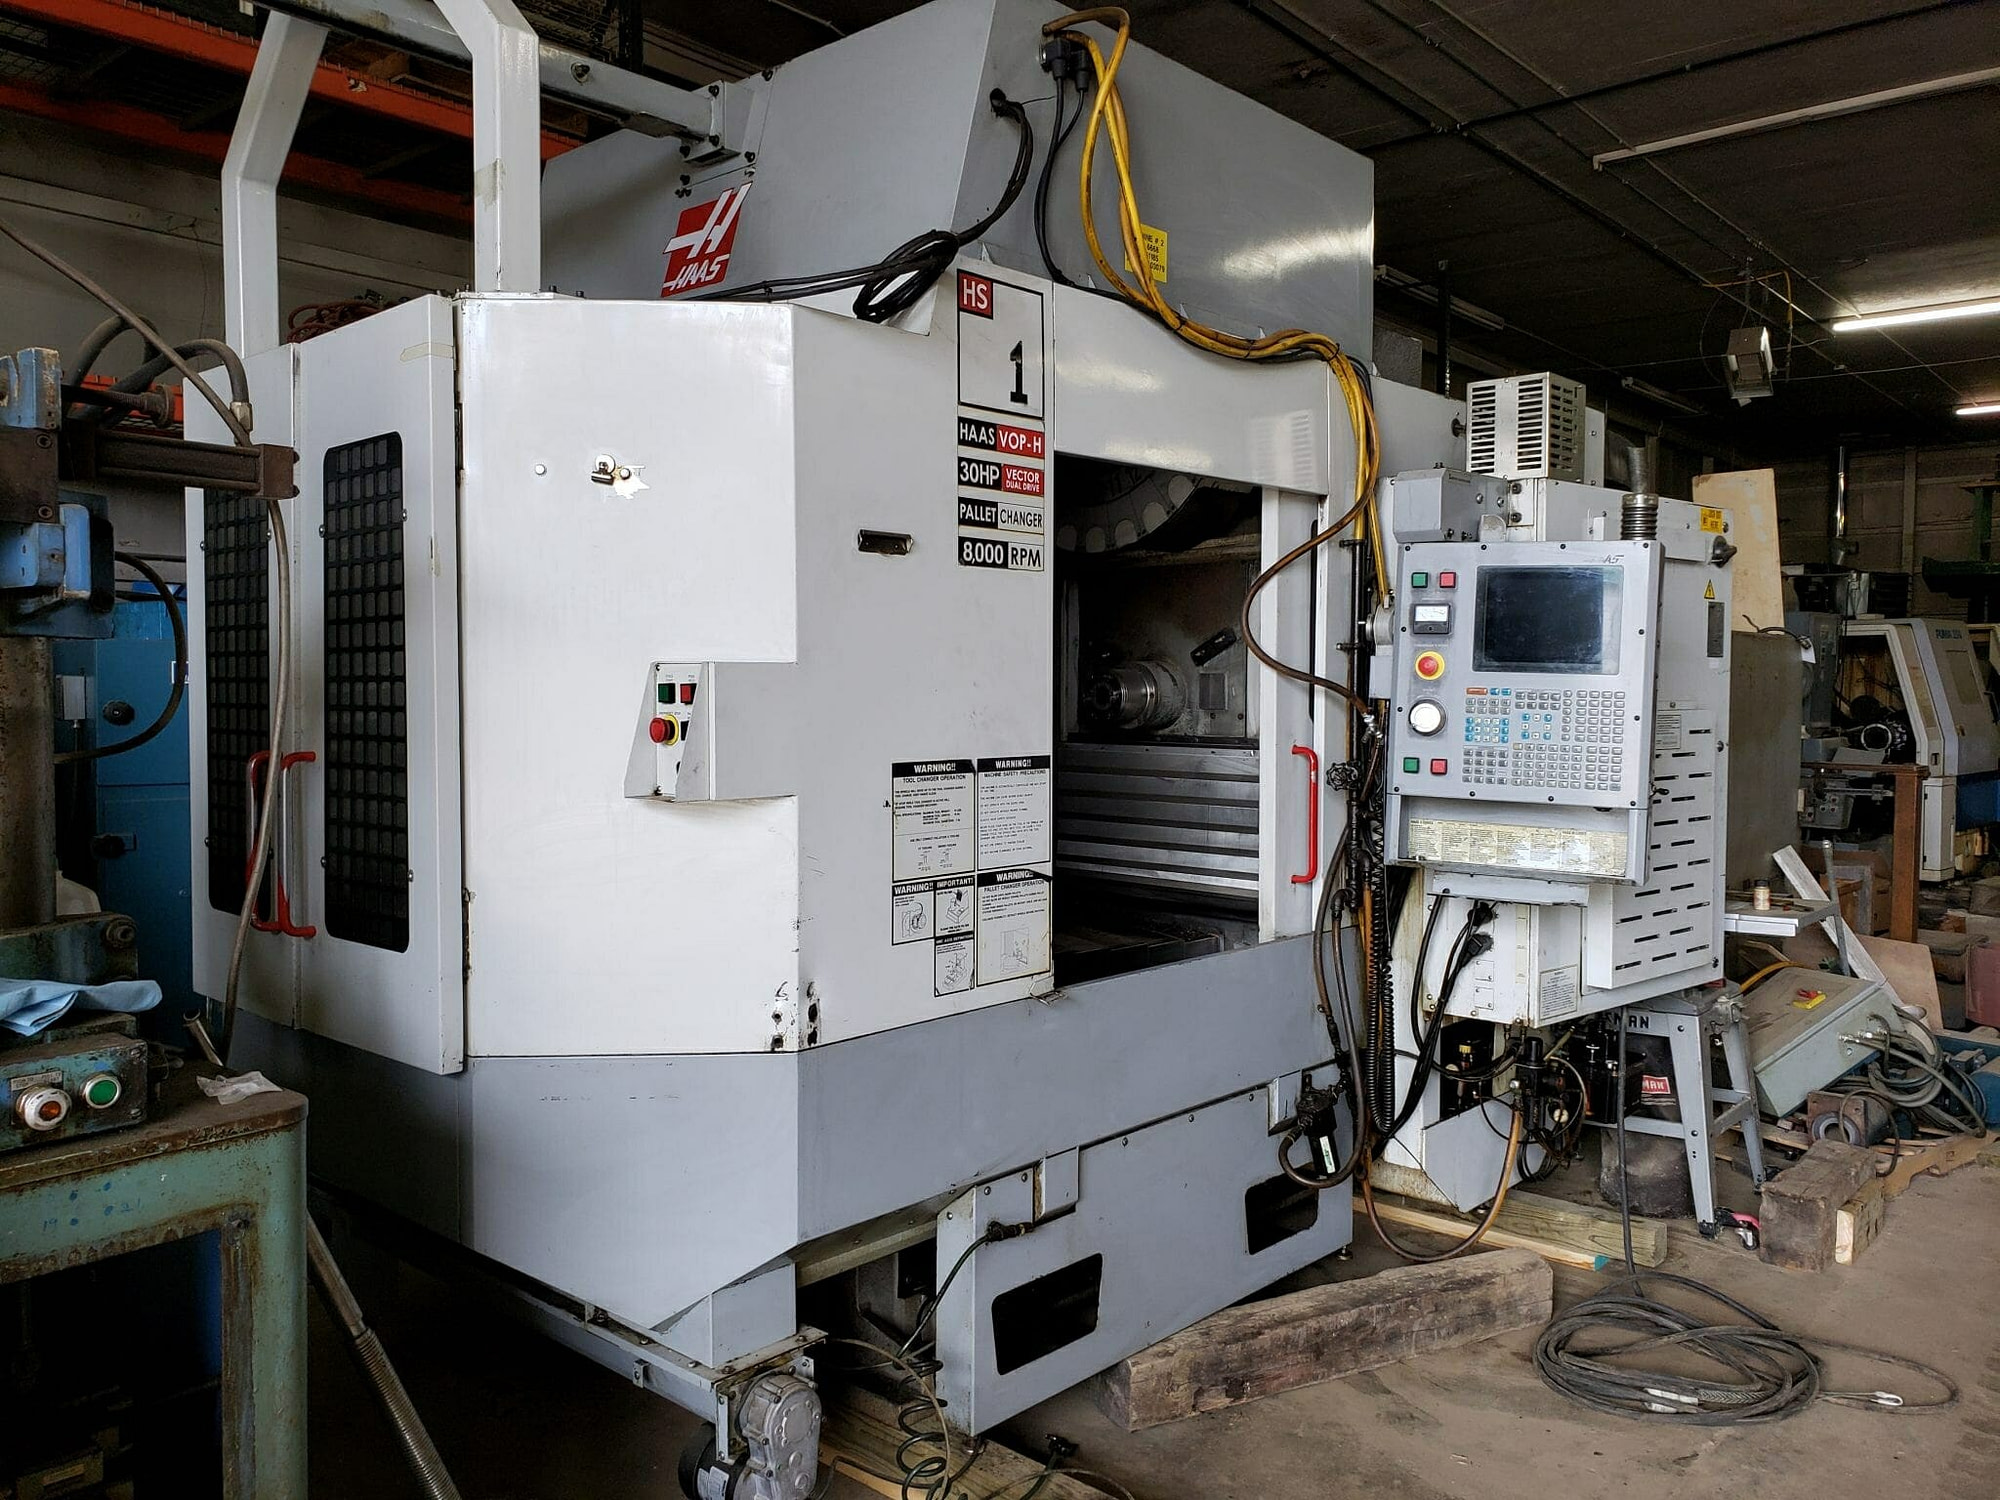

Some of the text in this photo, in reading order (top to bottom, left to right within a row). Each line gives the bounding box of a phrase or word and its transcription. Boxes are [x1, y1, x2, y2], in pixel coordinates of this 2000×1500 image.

[663, 254, 731, 291] HAAS
[962, 278, 989, 311] HS
[1009, 340, 1028, 405] 1
[960, 422, 1042, 455] HAAS VOP-H
[960, 461, 1040, 486] 30HP VECTOR
[1005, 480, 1040, 493] DUAL DRIVE
[959, 502, 1043, 529] PALLET CHANGER
[962, 541, 1041, 568] 8,000 RPM
[914, 762, 956, 774] WARNING!!
[995, 759, 1032, 769] WARNING!!
[903, 774, 966, 784] TOOL CHANGER OPERATION
[1003, 770, 1019, 778] SAFETY
[894, 882, 934, 895] WARNING!!
[983, 879, 1045, 893] PALLET CHANGER OPERATION
